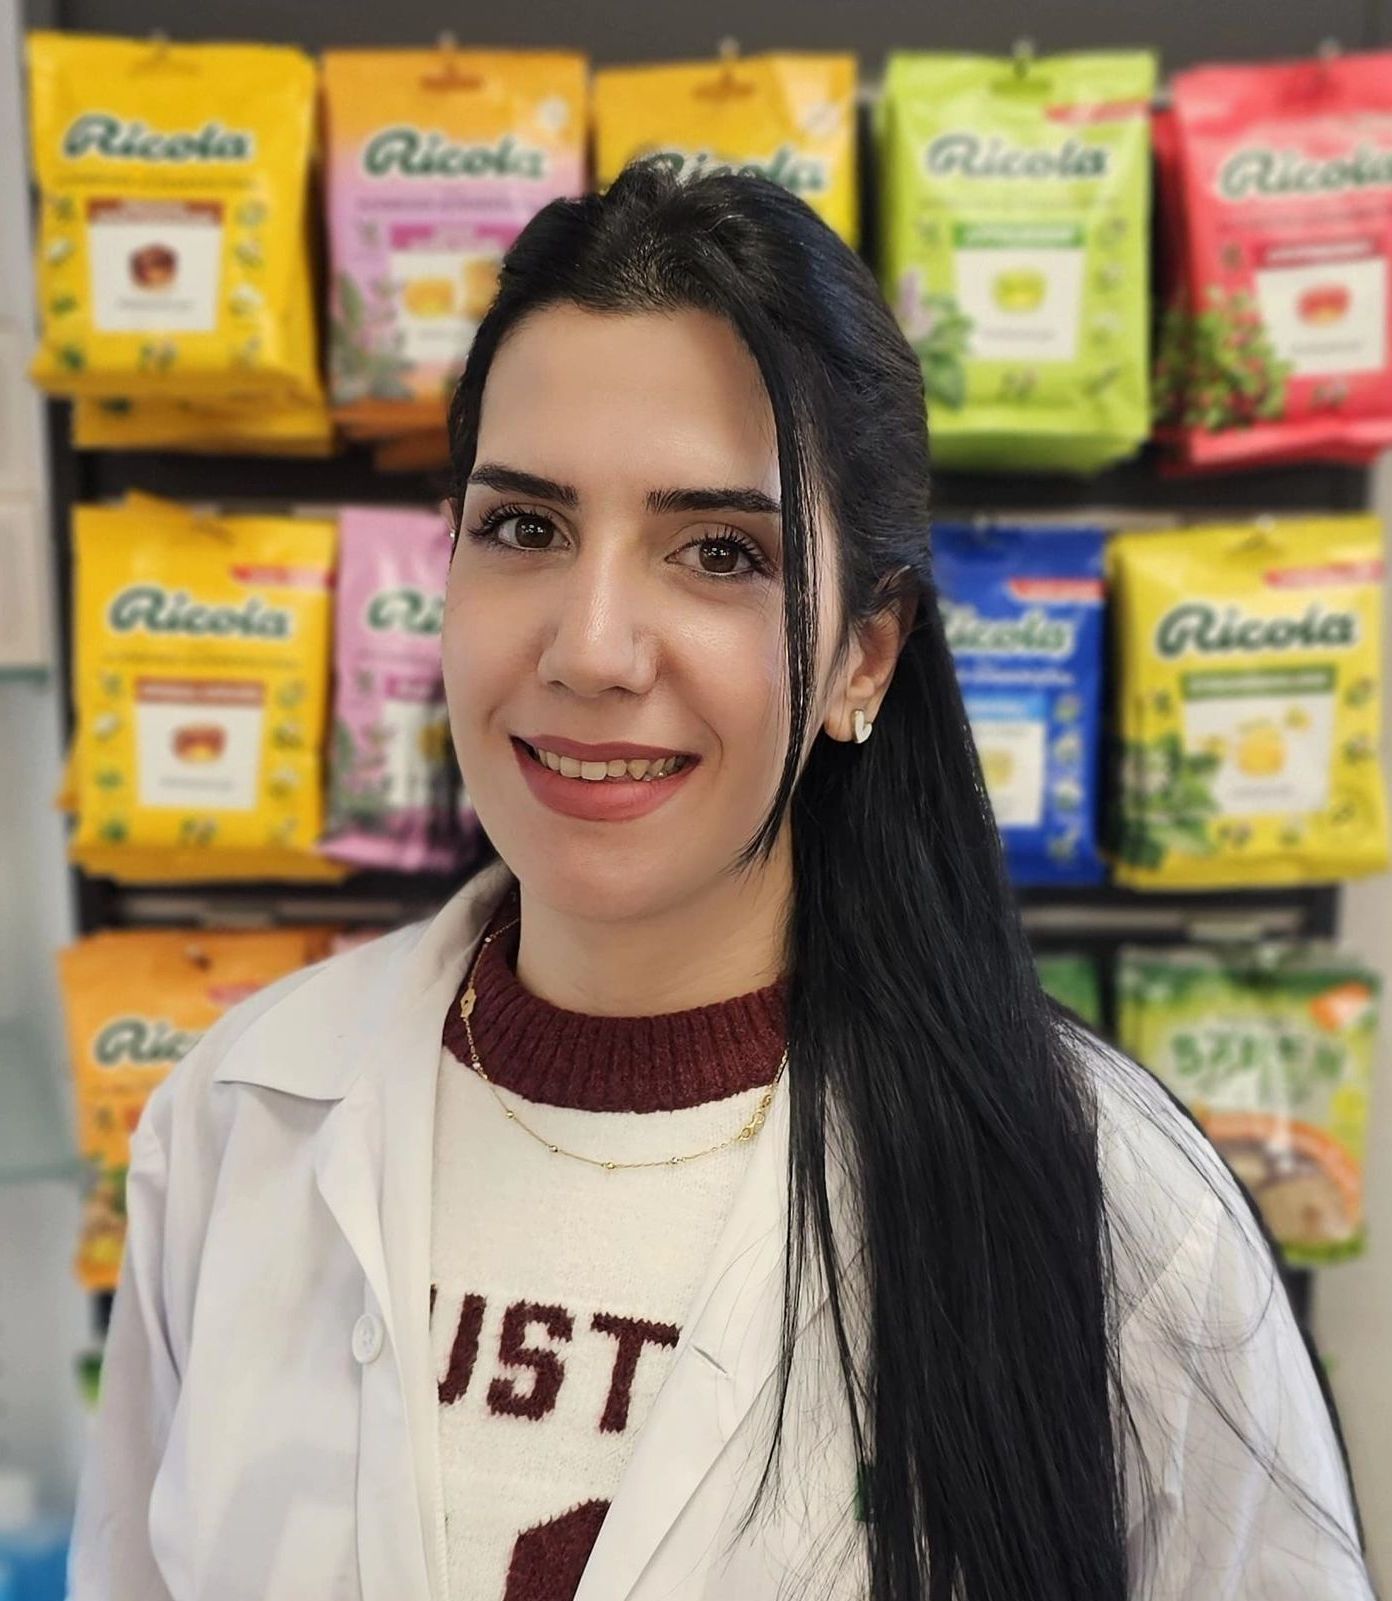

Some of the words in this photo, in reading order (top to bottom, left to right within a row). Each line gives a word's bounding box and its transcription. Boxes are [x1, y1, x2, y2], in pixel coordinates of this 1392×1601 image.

[65, 115, 251, 162] Ricola
[364, 129, 543, 178] Ricola
[928, 134, 1109, 177] Ricola
[109, 587, 290, 637] Ricola
[368, 589, 443, 634] Ri
[938, 602, 1068, 653] icola
[1157, 603, 1356, 659] Ricola
[95, 1017, 203, 1066] Ric
